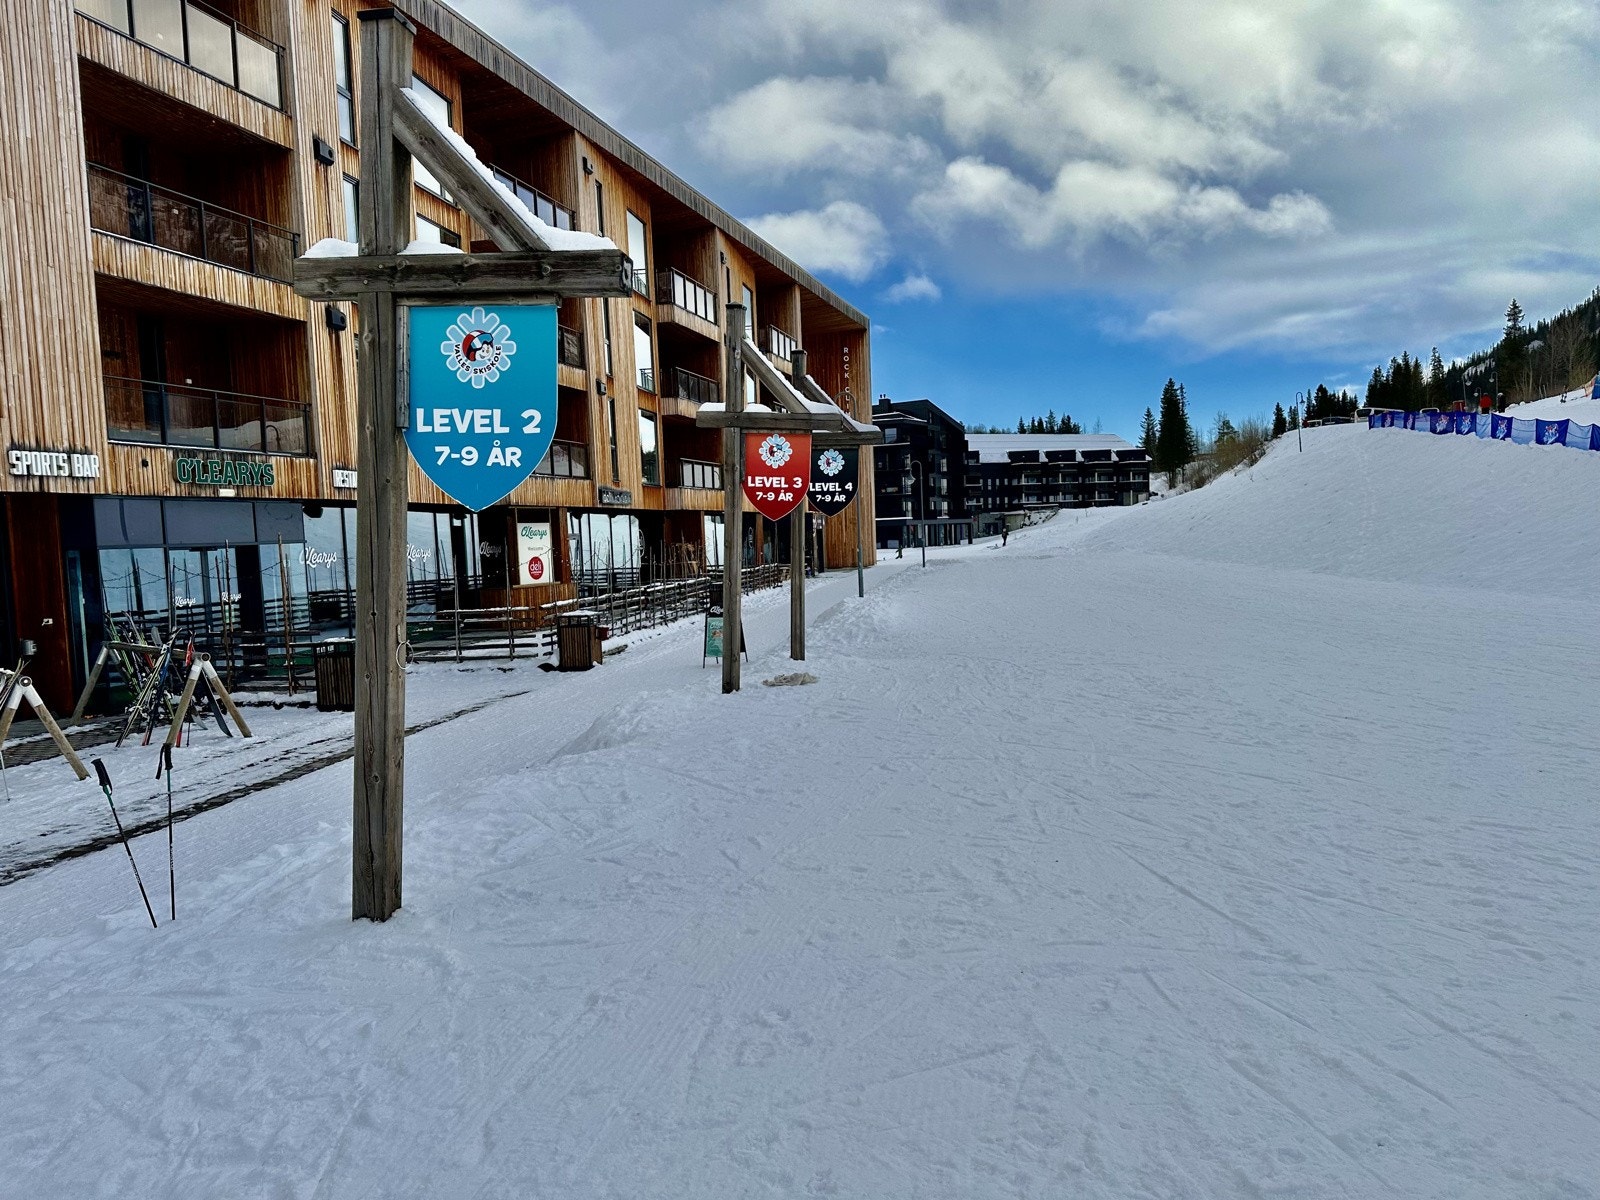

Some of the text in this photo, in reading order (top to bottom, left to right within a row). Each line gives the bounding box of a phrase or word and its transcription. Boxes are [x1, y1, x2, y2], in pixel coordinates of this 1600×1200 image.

[454, 343, 502, 375] VALLES SKISKOLE
[416, 408, 542, 434] LEVEL 2
[434, 440, 522, 468] 7-9 ÅR
[9, 450, 100, 478] SPORTS BAR
[176, 457, 275, 486] O'LEARYS
[747, 475, 803, 488] LEVEL 3
[809, 482, 853, 492] LEVEL 4
[755, 489, 793, 502] 7-9 ÅR
[815, 492, 846, 503] 7-9 ÅR
[520, 525, 548, 540] O'Learys
[299, 546, 337, 569] O'Learys
[529, 560, 542, 571] deli
